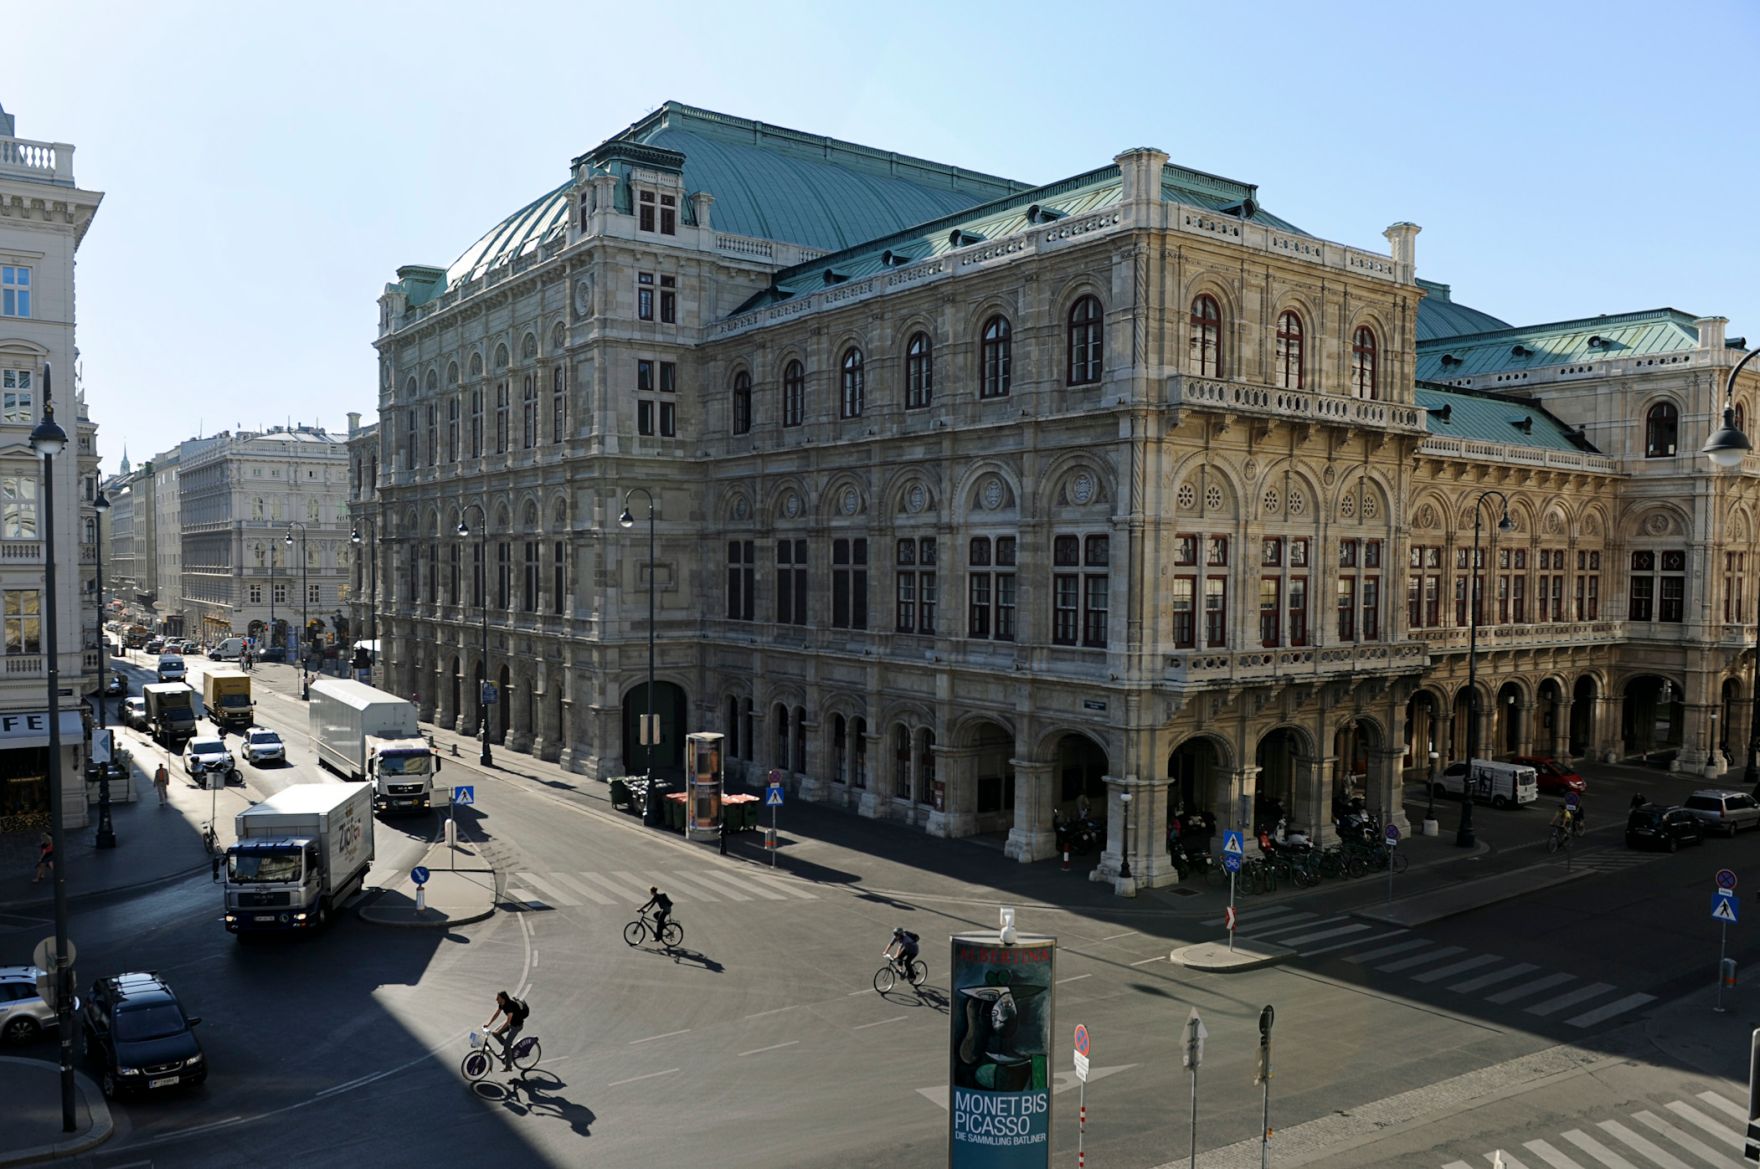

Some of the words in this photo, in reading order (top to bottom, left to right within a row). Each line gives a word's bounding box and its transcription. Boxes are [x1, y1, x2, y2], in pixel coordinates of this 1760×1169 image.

[961, 946, 1050, 965] ALBERTINA
[955, 1091, 1019, 1115] MONET
[1021, 1093, 1047, 1115] BIS
[955, 1111, 1030, 1136] PICASSO
[955, 1131, 967, 1141] DIE
[968, 1133, 1012, 1146] SAMMLUNG
[1013, 1132, 1047, 1146] BATLINER
